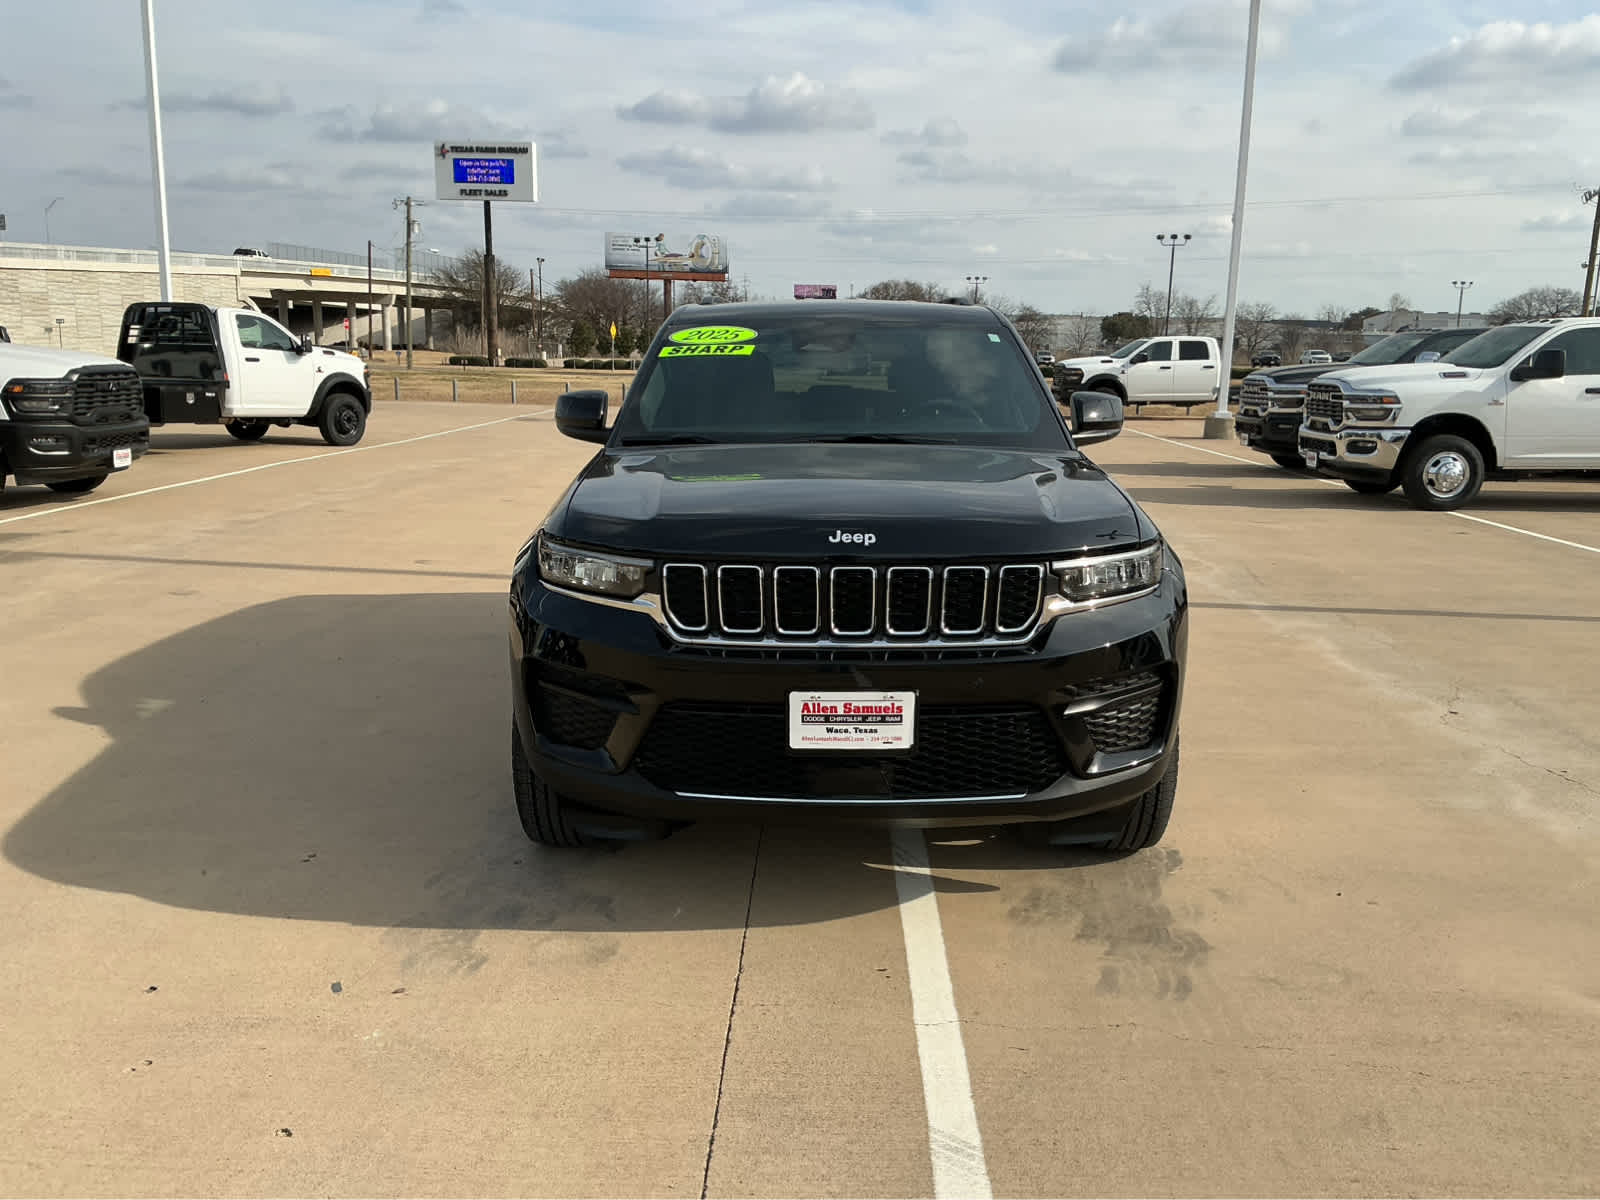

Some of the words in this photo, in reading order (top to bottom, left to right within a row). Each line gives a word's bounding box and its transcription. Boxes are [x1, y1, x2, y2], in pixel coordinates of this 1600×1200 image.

[450, 145, 474, 153] TEXAS
[484, 189, 508, 197] SALES
[682, 329, 744, 341] 2025
[668, 345, 745, 355] SHARP
[1309, 392, 1330, 400] RAM
[829, 530, 876, 546] Jeep
[801, 703, 838, 714] Allen
[843, 703, 903, 714] Samuels
